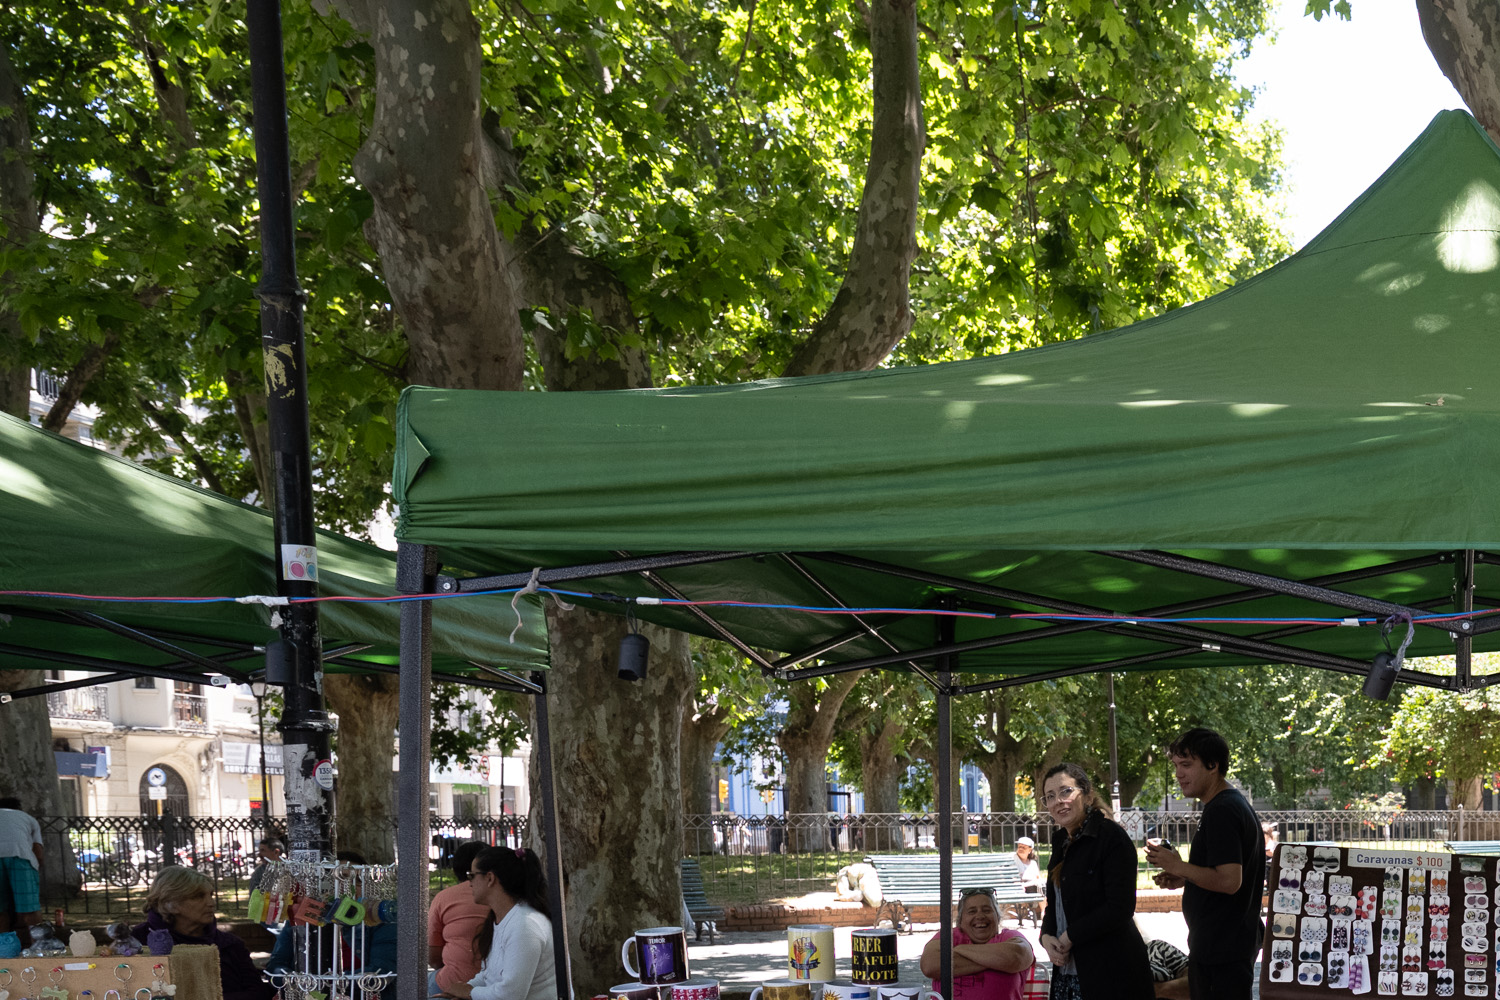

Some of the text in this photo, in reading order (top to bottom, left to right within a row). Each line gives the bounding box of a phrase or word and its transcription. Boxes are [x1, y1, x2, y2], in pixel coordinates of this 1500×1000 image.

[224, 765, 258, 773] SERVICE
[1356, 853, 1443, 868] Caravanas $ 100
